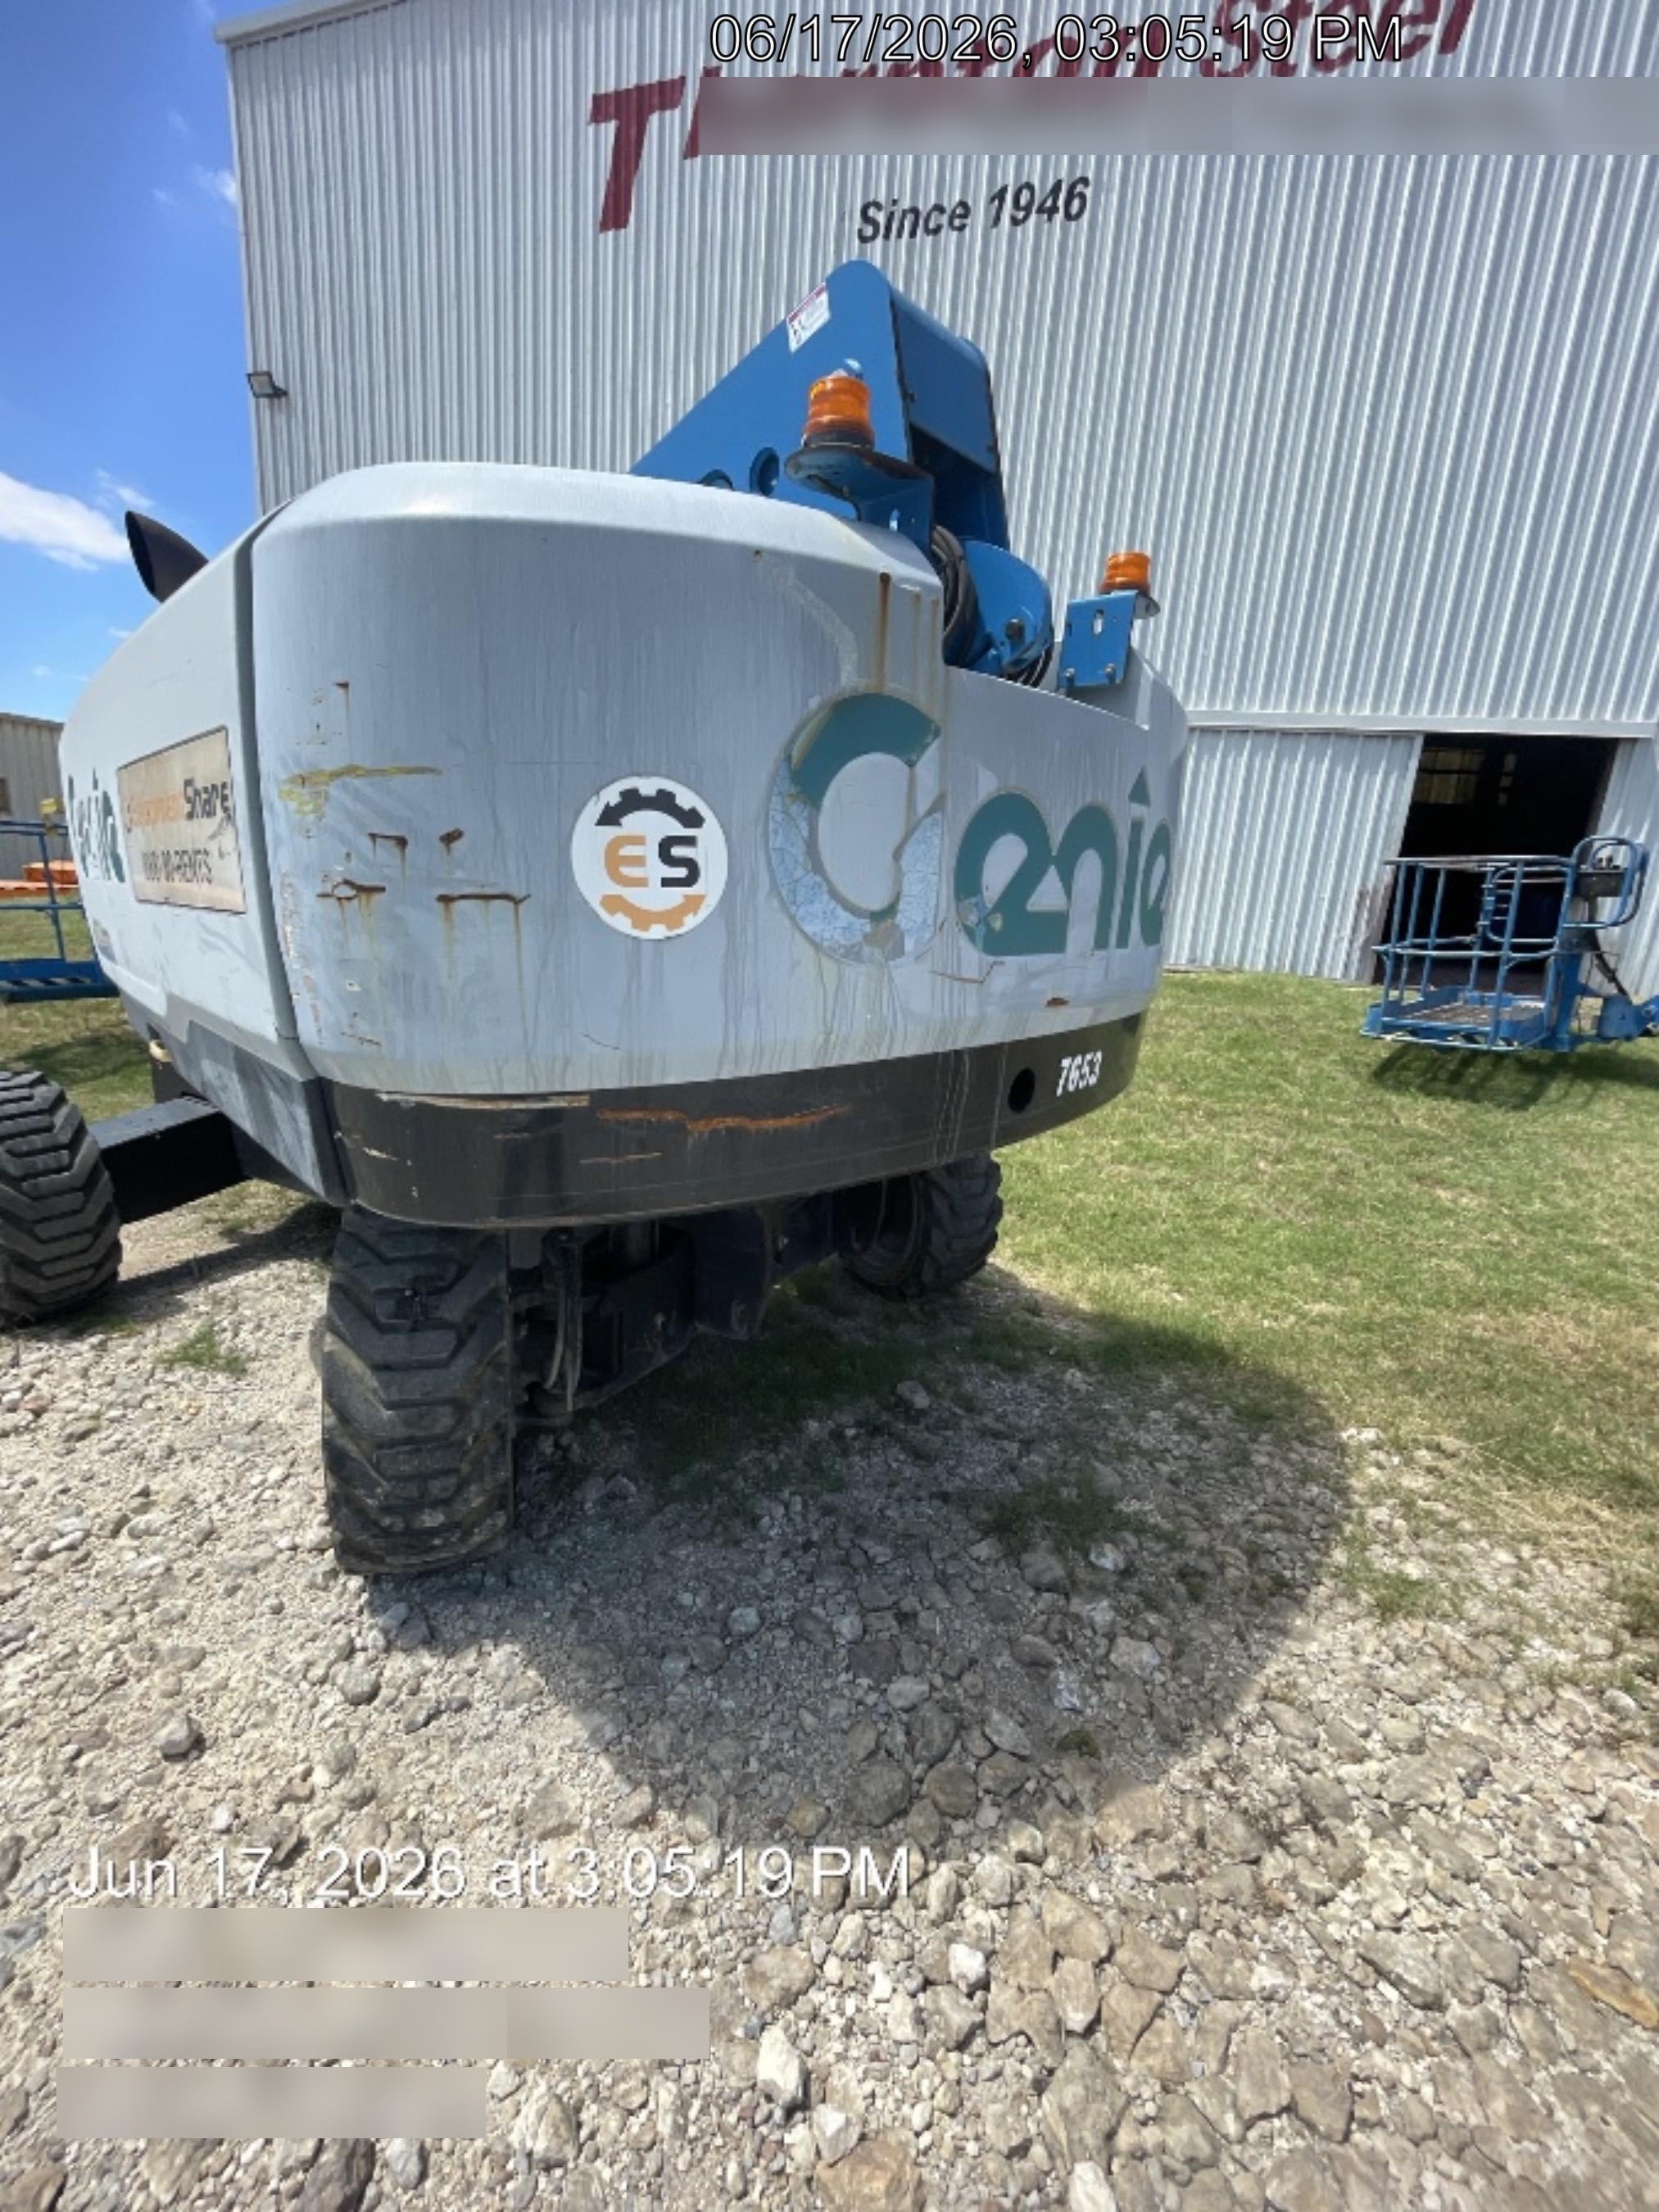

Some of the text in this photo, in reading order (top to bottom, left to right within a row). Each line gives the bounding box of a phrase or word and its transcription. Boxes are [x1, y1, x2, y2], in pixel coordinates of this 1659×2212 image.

[858, 176, 1090, 243] Since 1946
[768, 691, 1170, 965] Genie
[604, 834, 700, 887] ES
[1056, 1049, 1102, 1097] 7653
